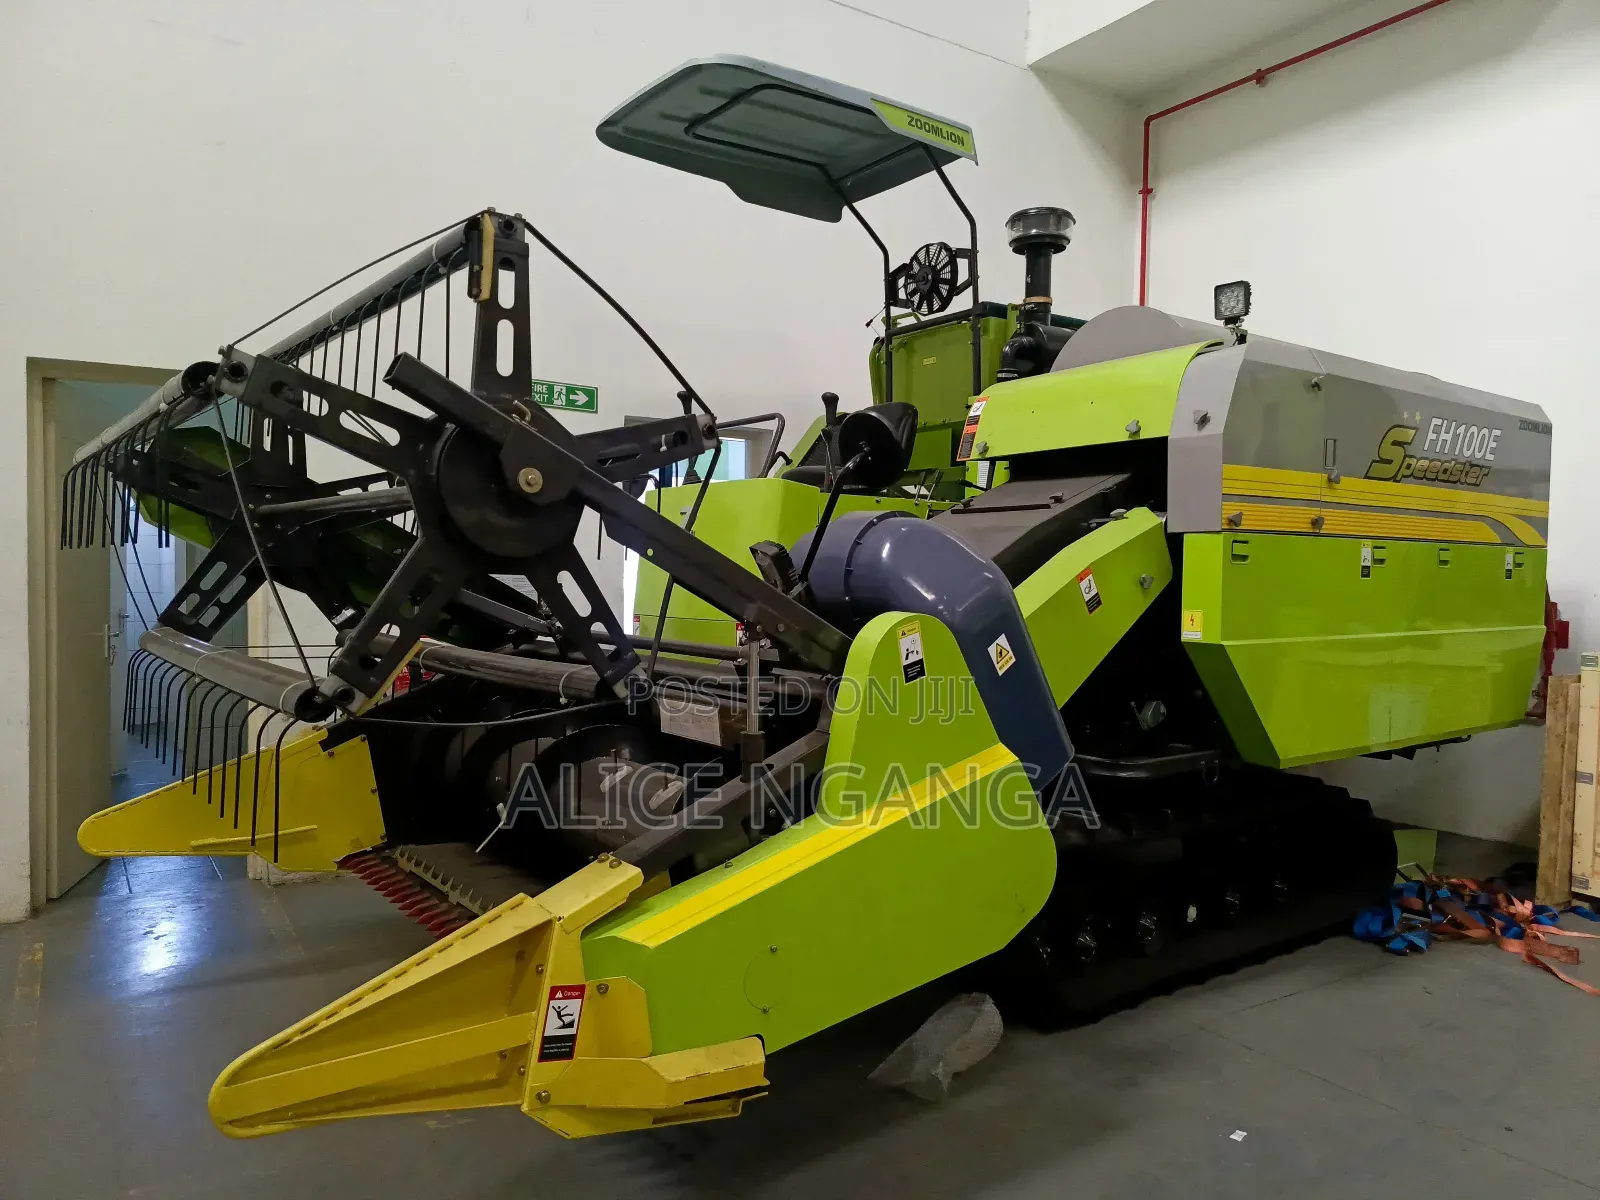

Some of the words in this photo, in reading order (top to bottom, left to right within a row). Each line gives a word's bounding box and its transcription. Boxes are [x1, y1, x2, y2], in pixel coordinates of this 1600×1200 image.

[906, 114, 965, 147] ZOOMLION
[1363, 424, 1492, 487] Speedster
[1423, 416, 1502, 461] FH100E
